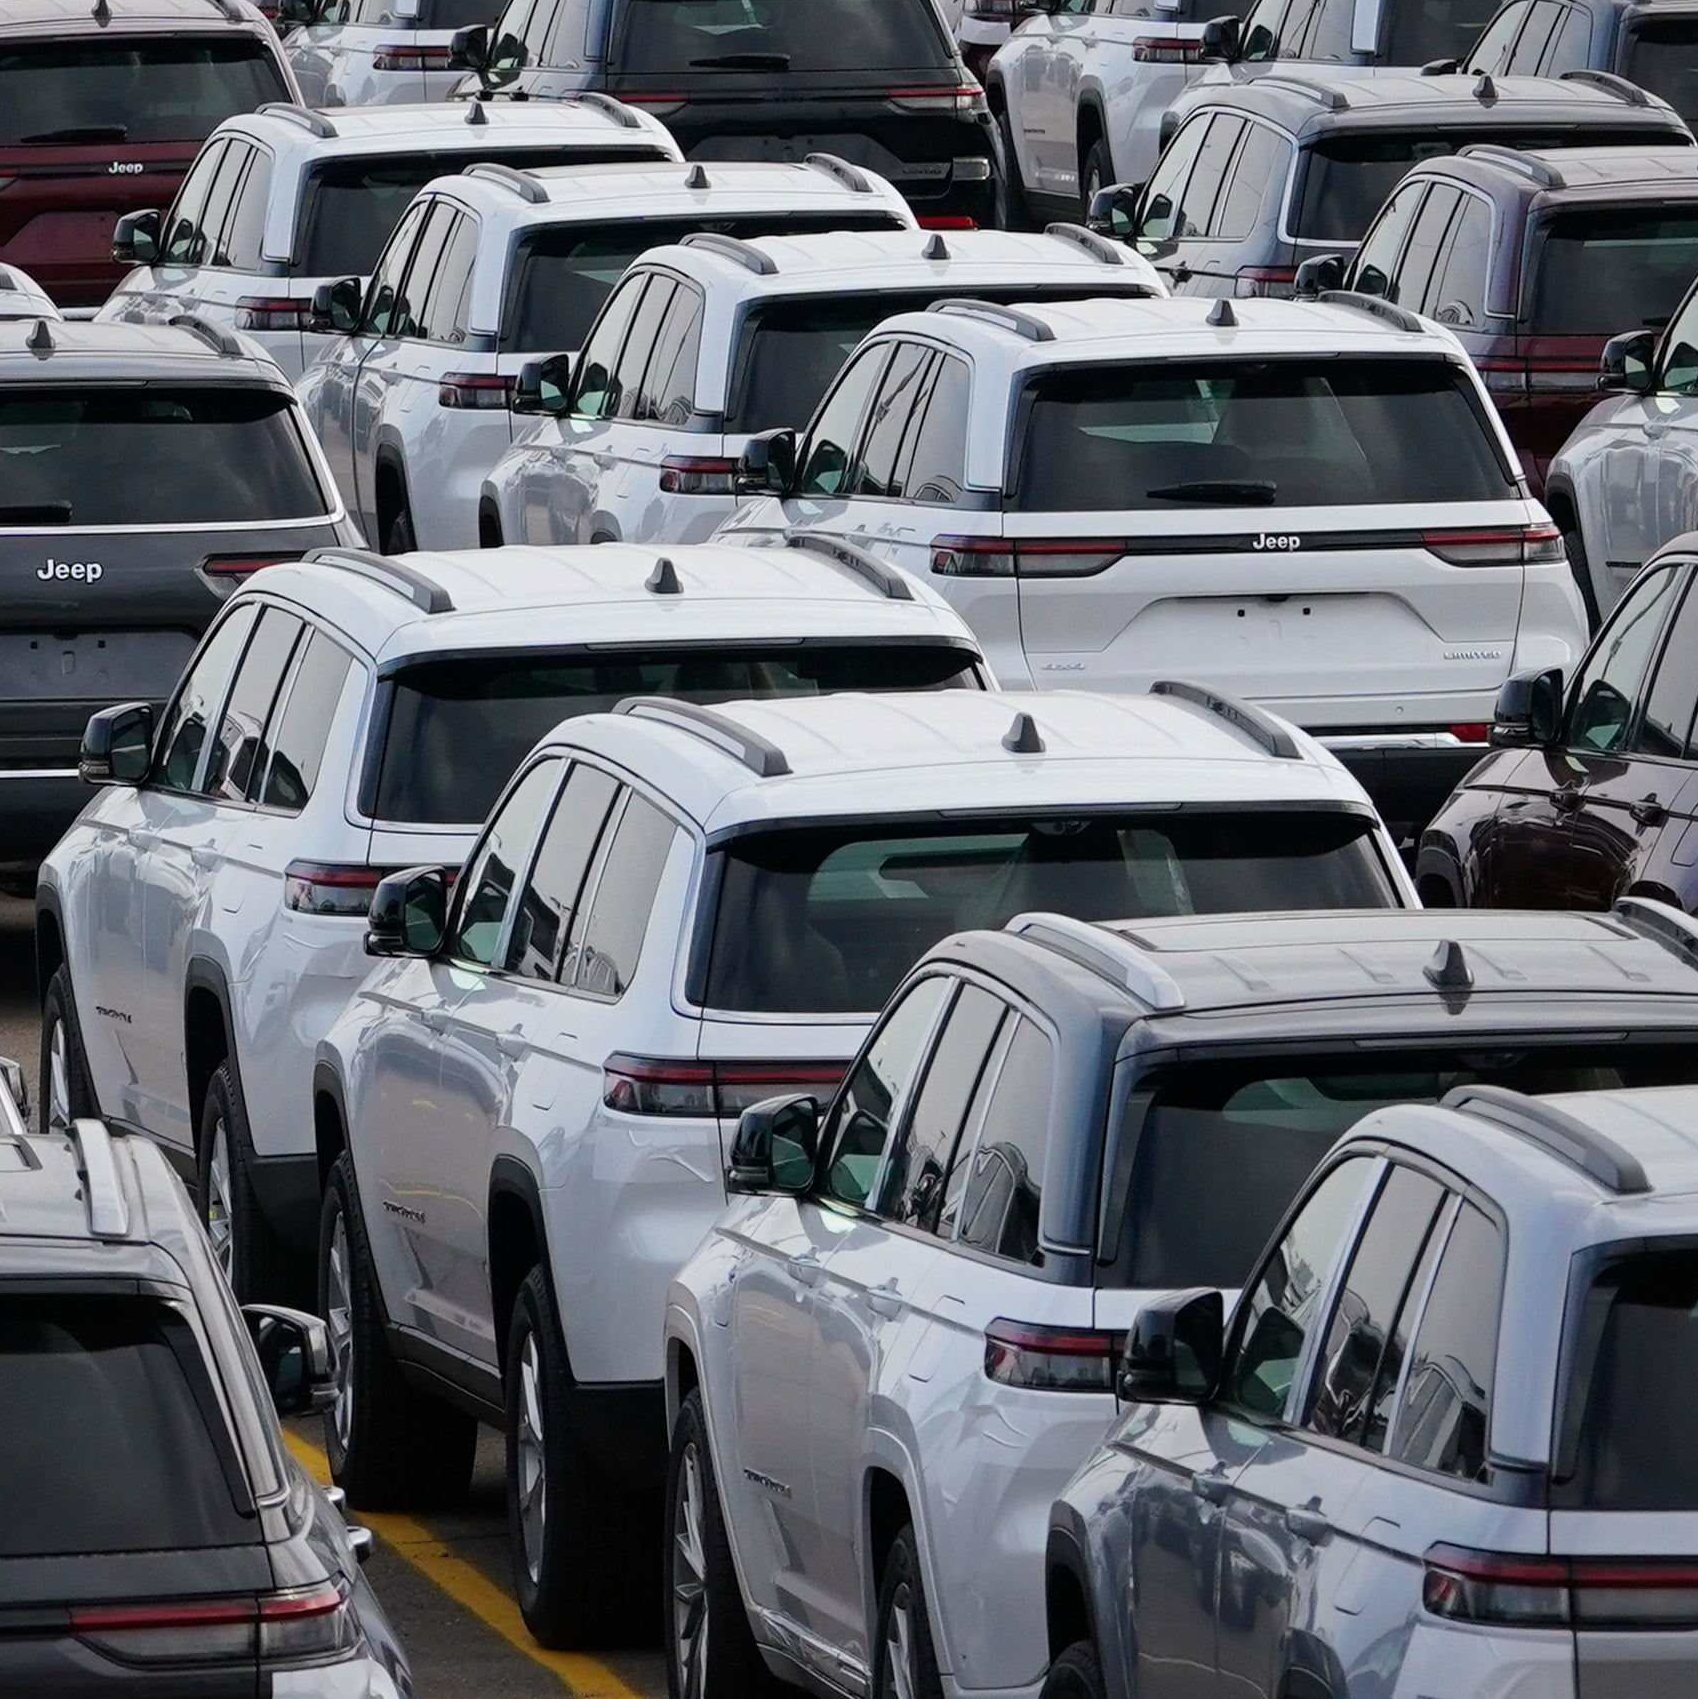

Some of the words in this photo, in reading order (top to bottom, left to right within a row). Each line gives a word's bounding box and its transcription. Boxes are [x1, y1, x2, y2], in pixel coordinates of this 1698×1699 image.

[108, 162, 143, 174] Jeep
[1252, 533, 1300, 552] Jeep
[36, 558, 103, 583] Jeep
[1444, 650, 1502, 660] LIMITED
